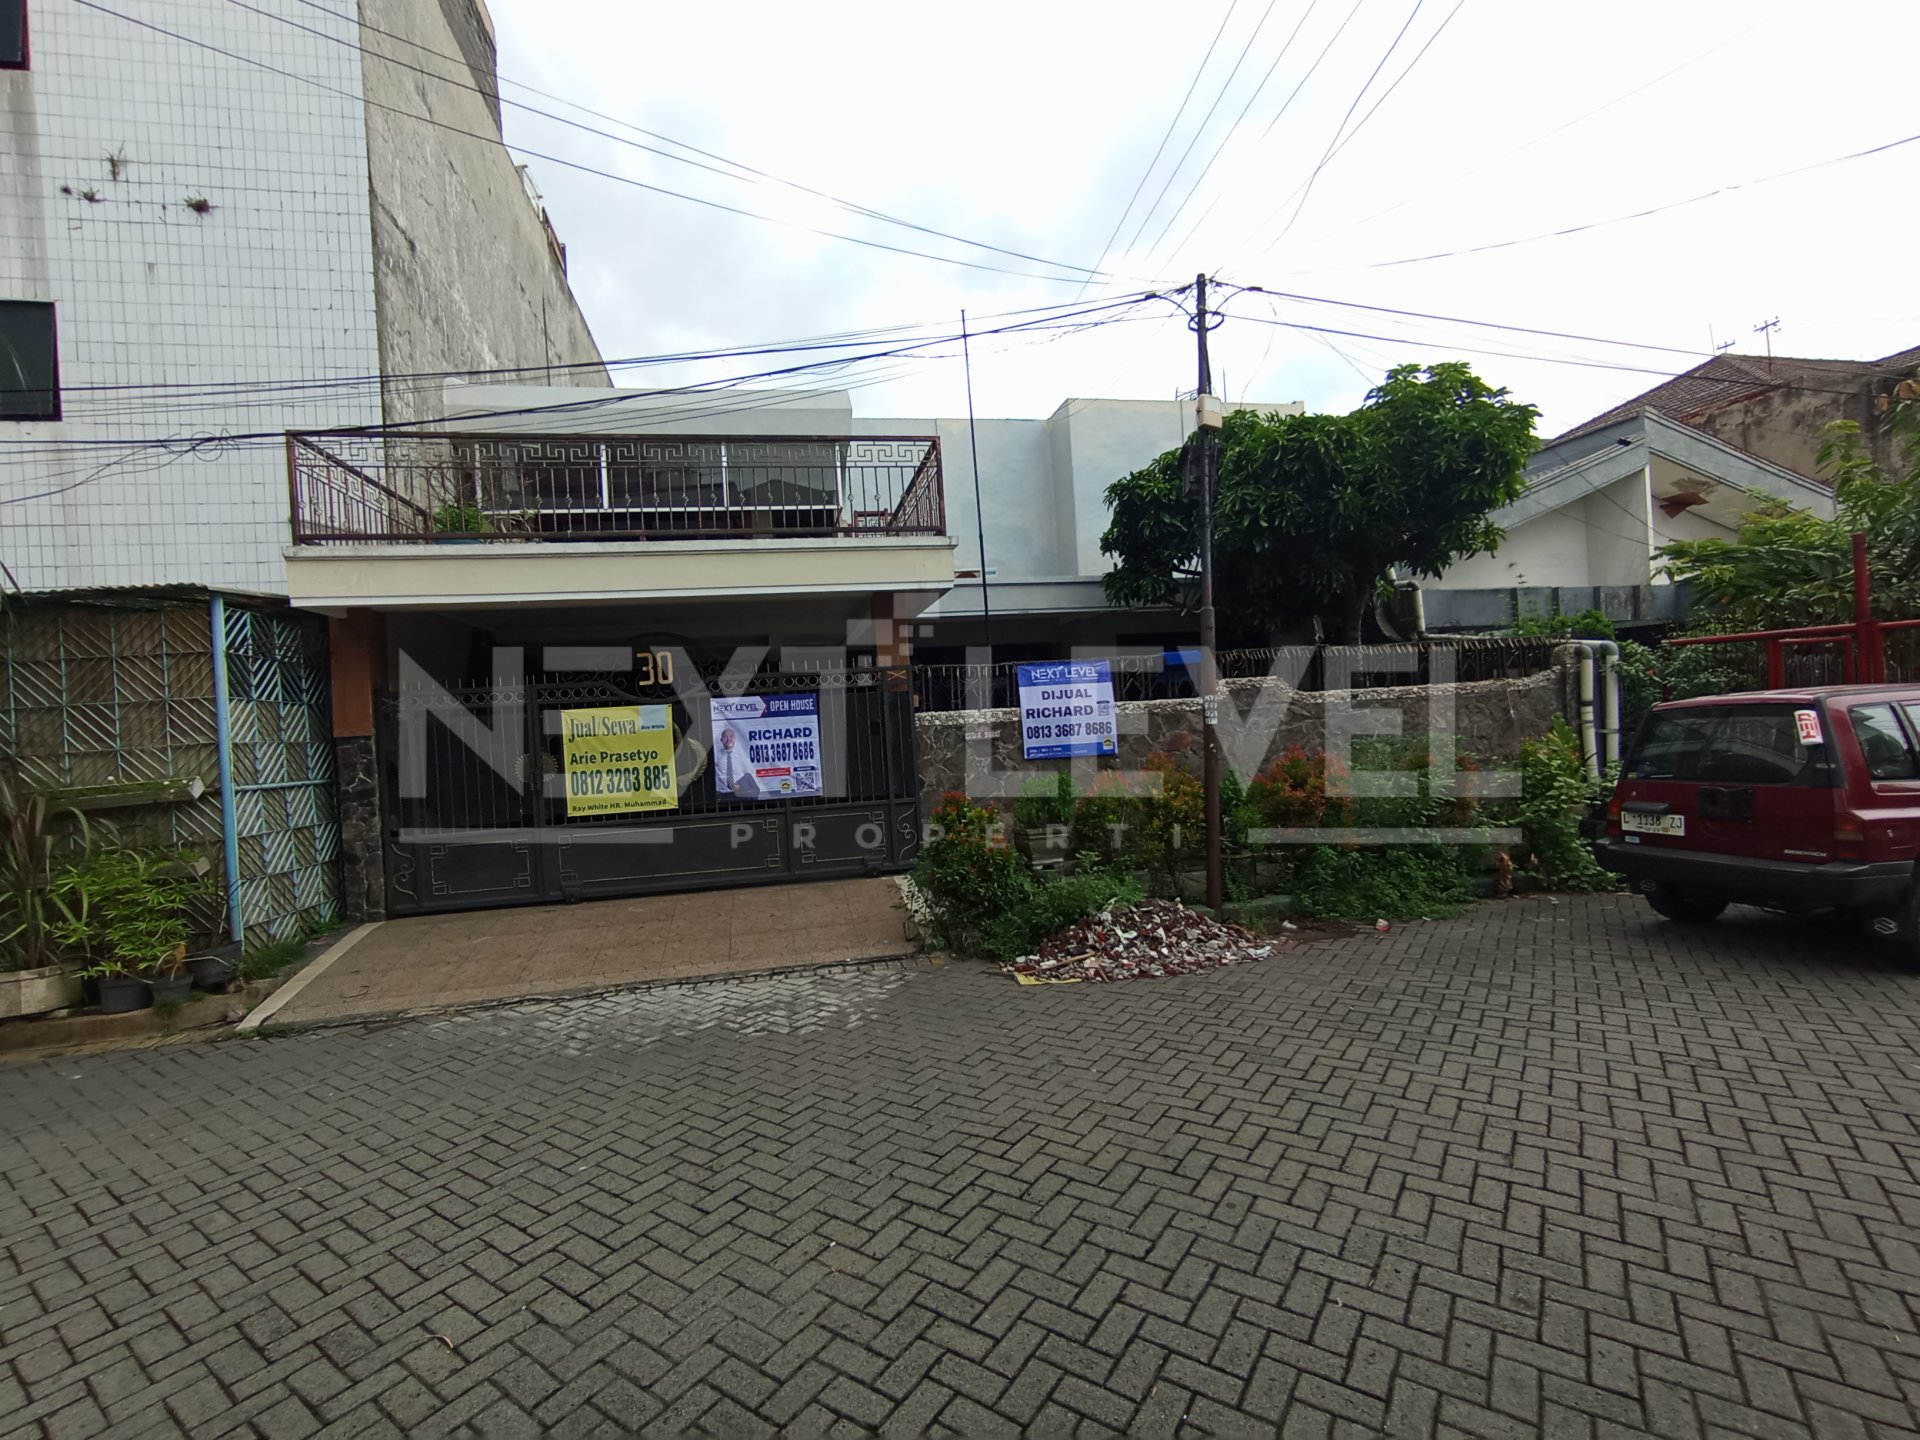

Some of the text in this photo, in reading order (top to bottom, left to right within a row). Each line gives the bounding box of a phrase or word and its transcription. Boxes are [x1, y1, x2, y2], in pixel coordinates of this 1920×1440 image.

[636, 651, 673, 686] 30
[1031, 666, 1099, 680] NEXT LEVEL
[1041, 688, 1093, 700] DIJUAL
[713, 702, 758, 712] NEXT LEVEL
[770, 699, 815, 712] OPEN HOUSE
[1026, 705, 1094, 719] RICHARD
[748, 727, 813, 741] RICHARD
[1026, 721, 1112, 739] 0813 3687 8686
[570, 749, 658, 765] Arie Prasetyo
[749, 741, 815, 764] 0813 3687 8686
[571, 765, 671, 796] 0812 3283 885
[587, 803, 608, 811] White
[624, 798, 667, 808] Muhammad
[1623, 813, 1629, 824] L
